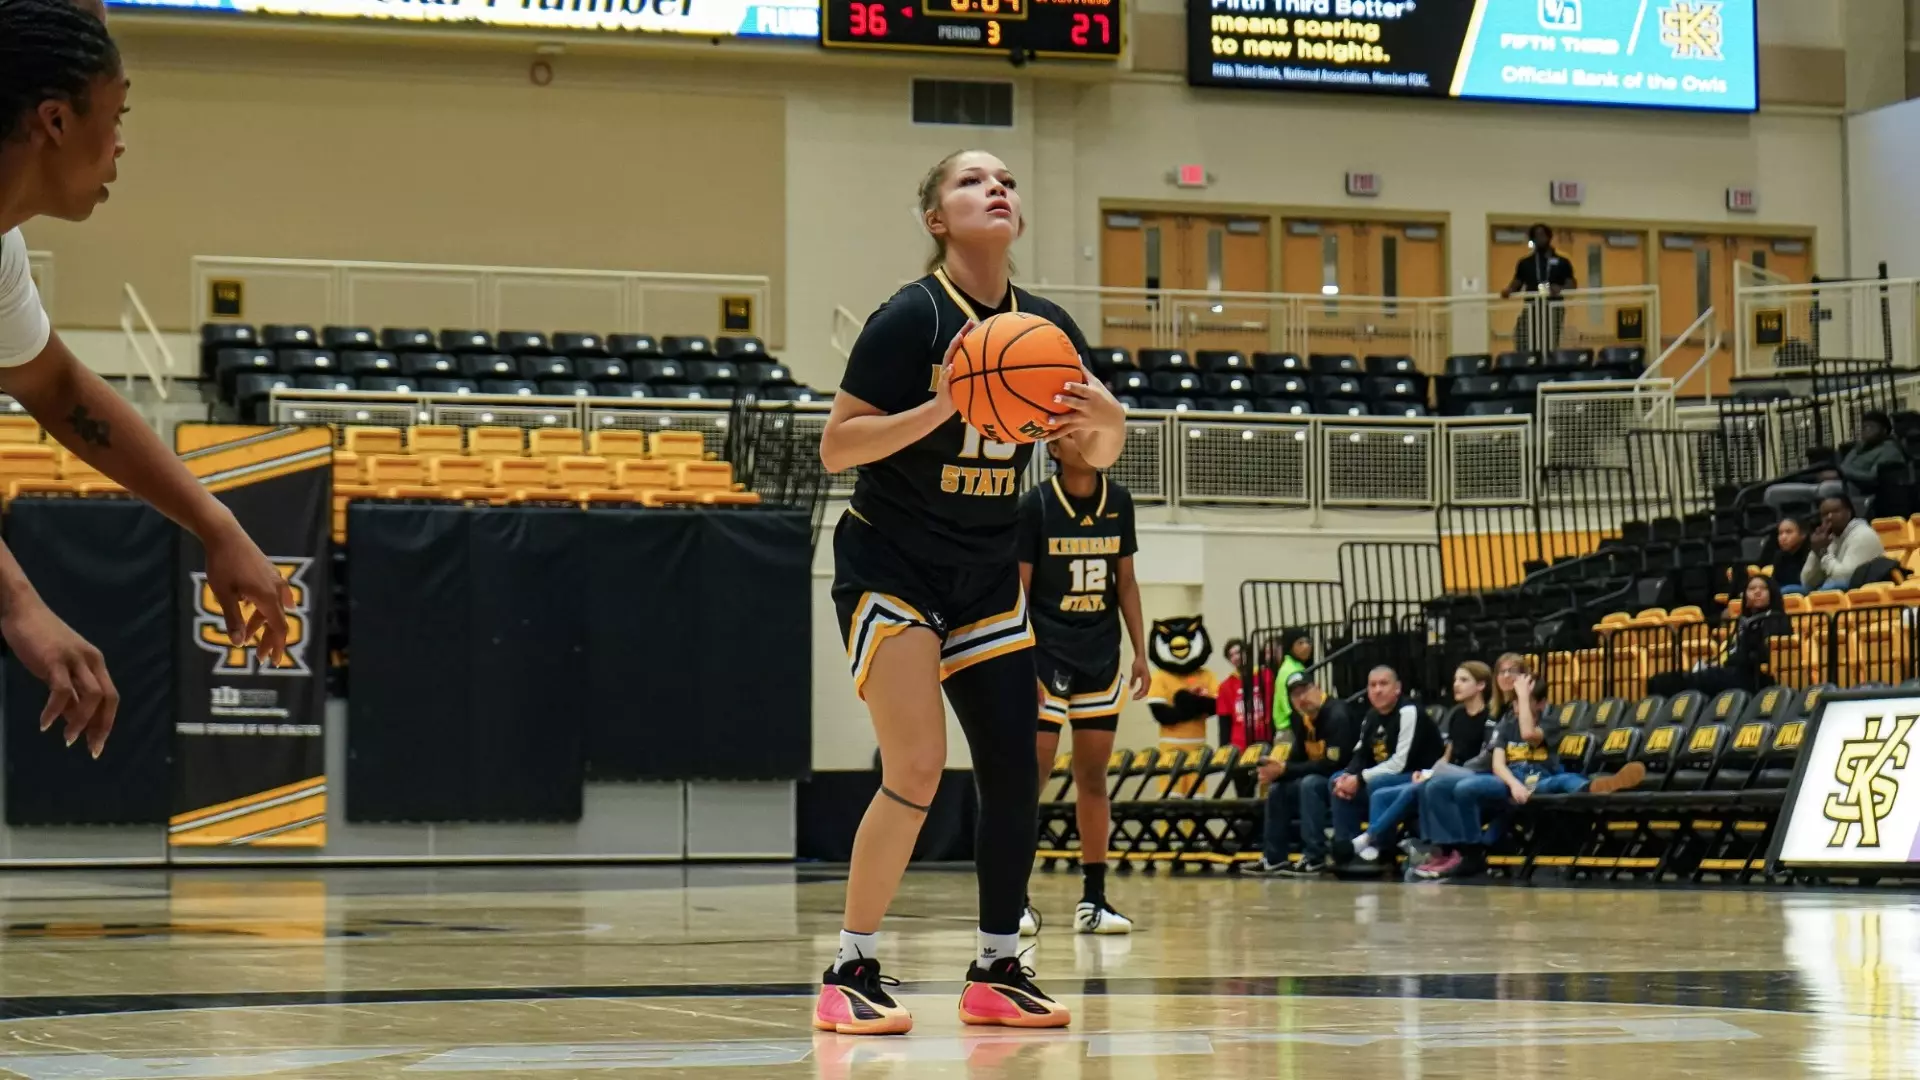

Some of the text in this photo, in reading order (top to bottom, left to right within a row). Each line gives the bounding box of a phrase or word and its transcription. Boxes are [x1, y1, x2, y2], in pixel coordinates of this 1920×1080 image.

[850, 3, 887, 36] 36
[938, 20, 1000, 45] PERIOD 3
[1071, 13, 1110, 45] 27
[1211, 15, 1380, 42] means soaring
[1211, 35, 1391, 63] to new heights.
[1502, 65, 1728, 93] Official Bank of the Owls
[1069, 559, 1107, 592] 12
